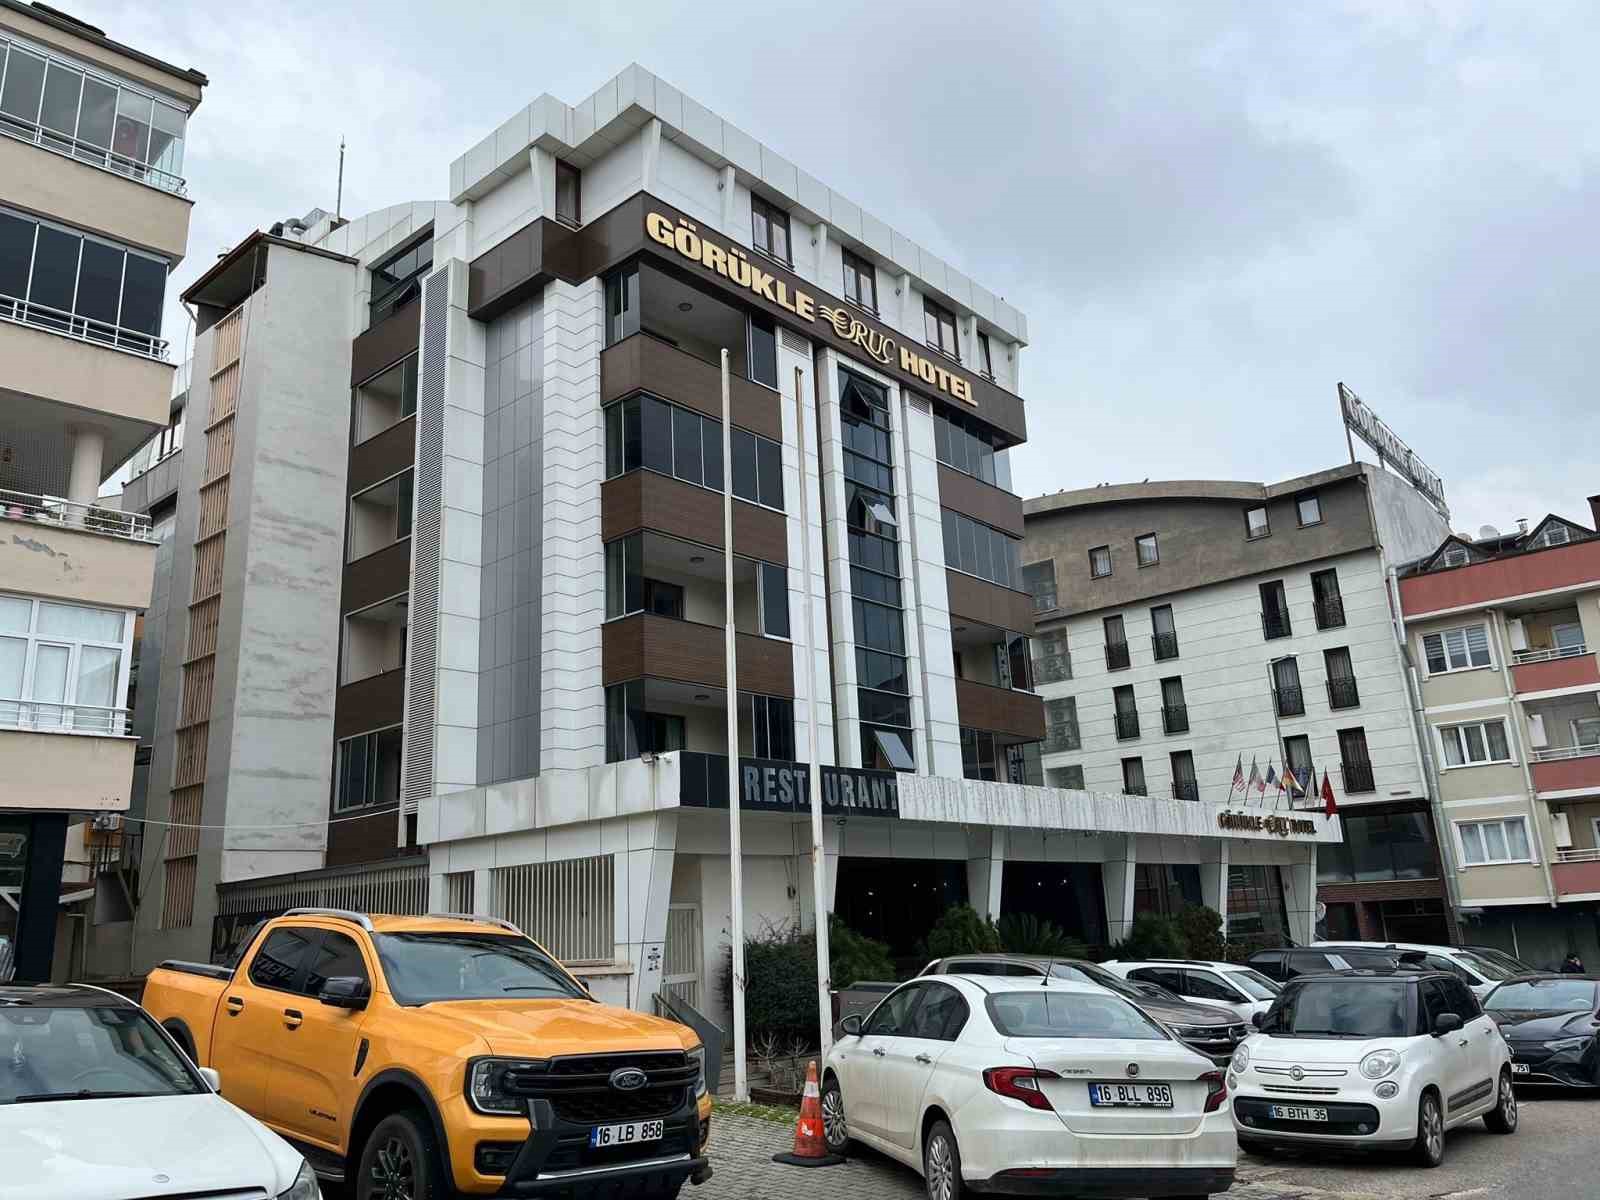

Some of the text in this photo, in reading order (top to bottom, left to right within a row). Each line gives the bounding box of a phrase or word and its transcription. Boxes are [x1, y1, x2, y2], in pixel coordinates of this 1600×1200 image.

[646, 212, 815, 322] GÖRÜKLE
[900, 347, 978, 407] HOTEL
[743, 765, 897, 811] RESTURANT
[1098, 1086, 1169, 1102] 16 BLL 896
[1274, 1107, 1326, 1120] 16 BTH 35
[599, 1122, 662, 1145] 16 LB 858
